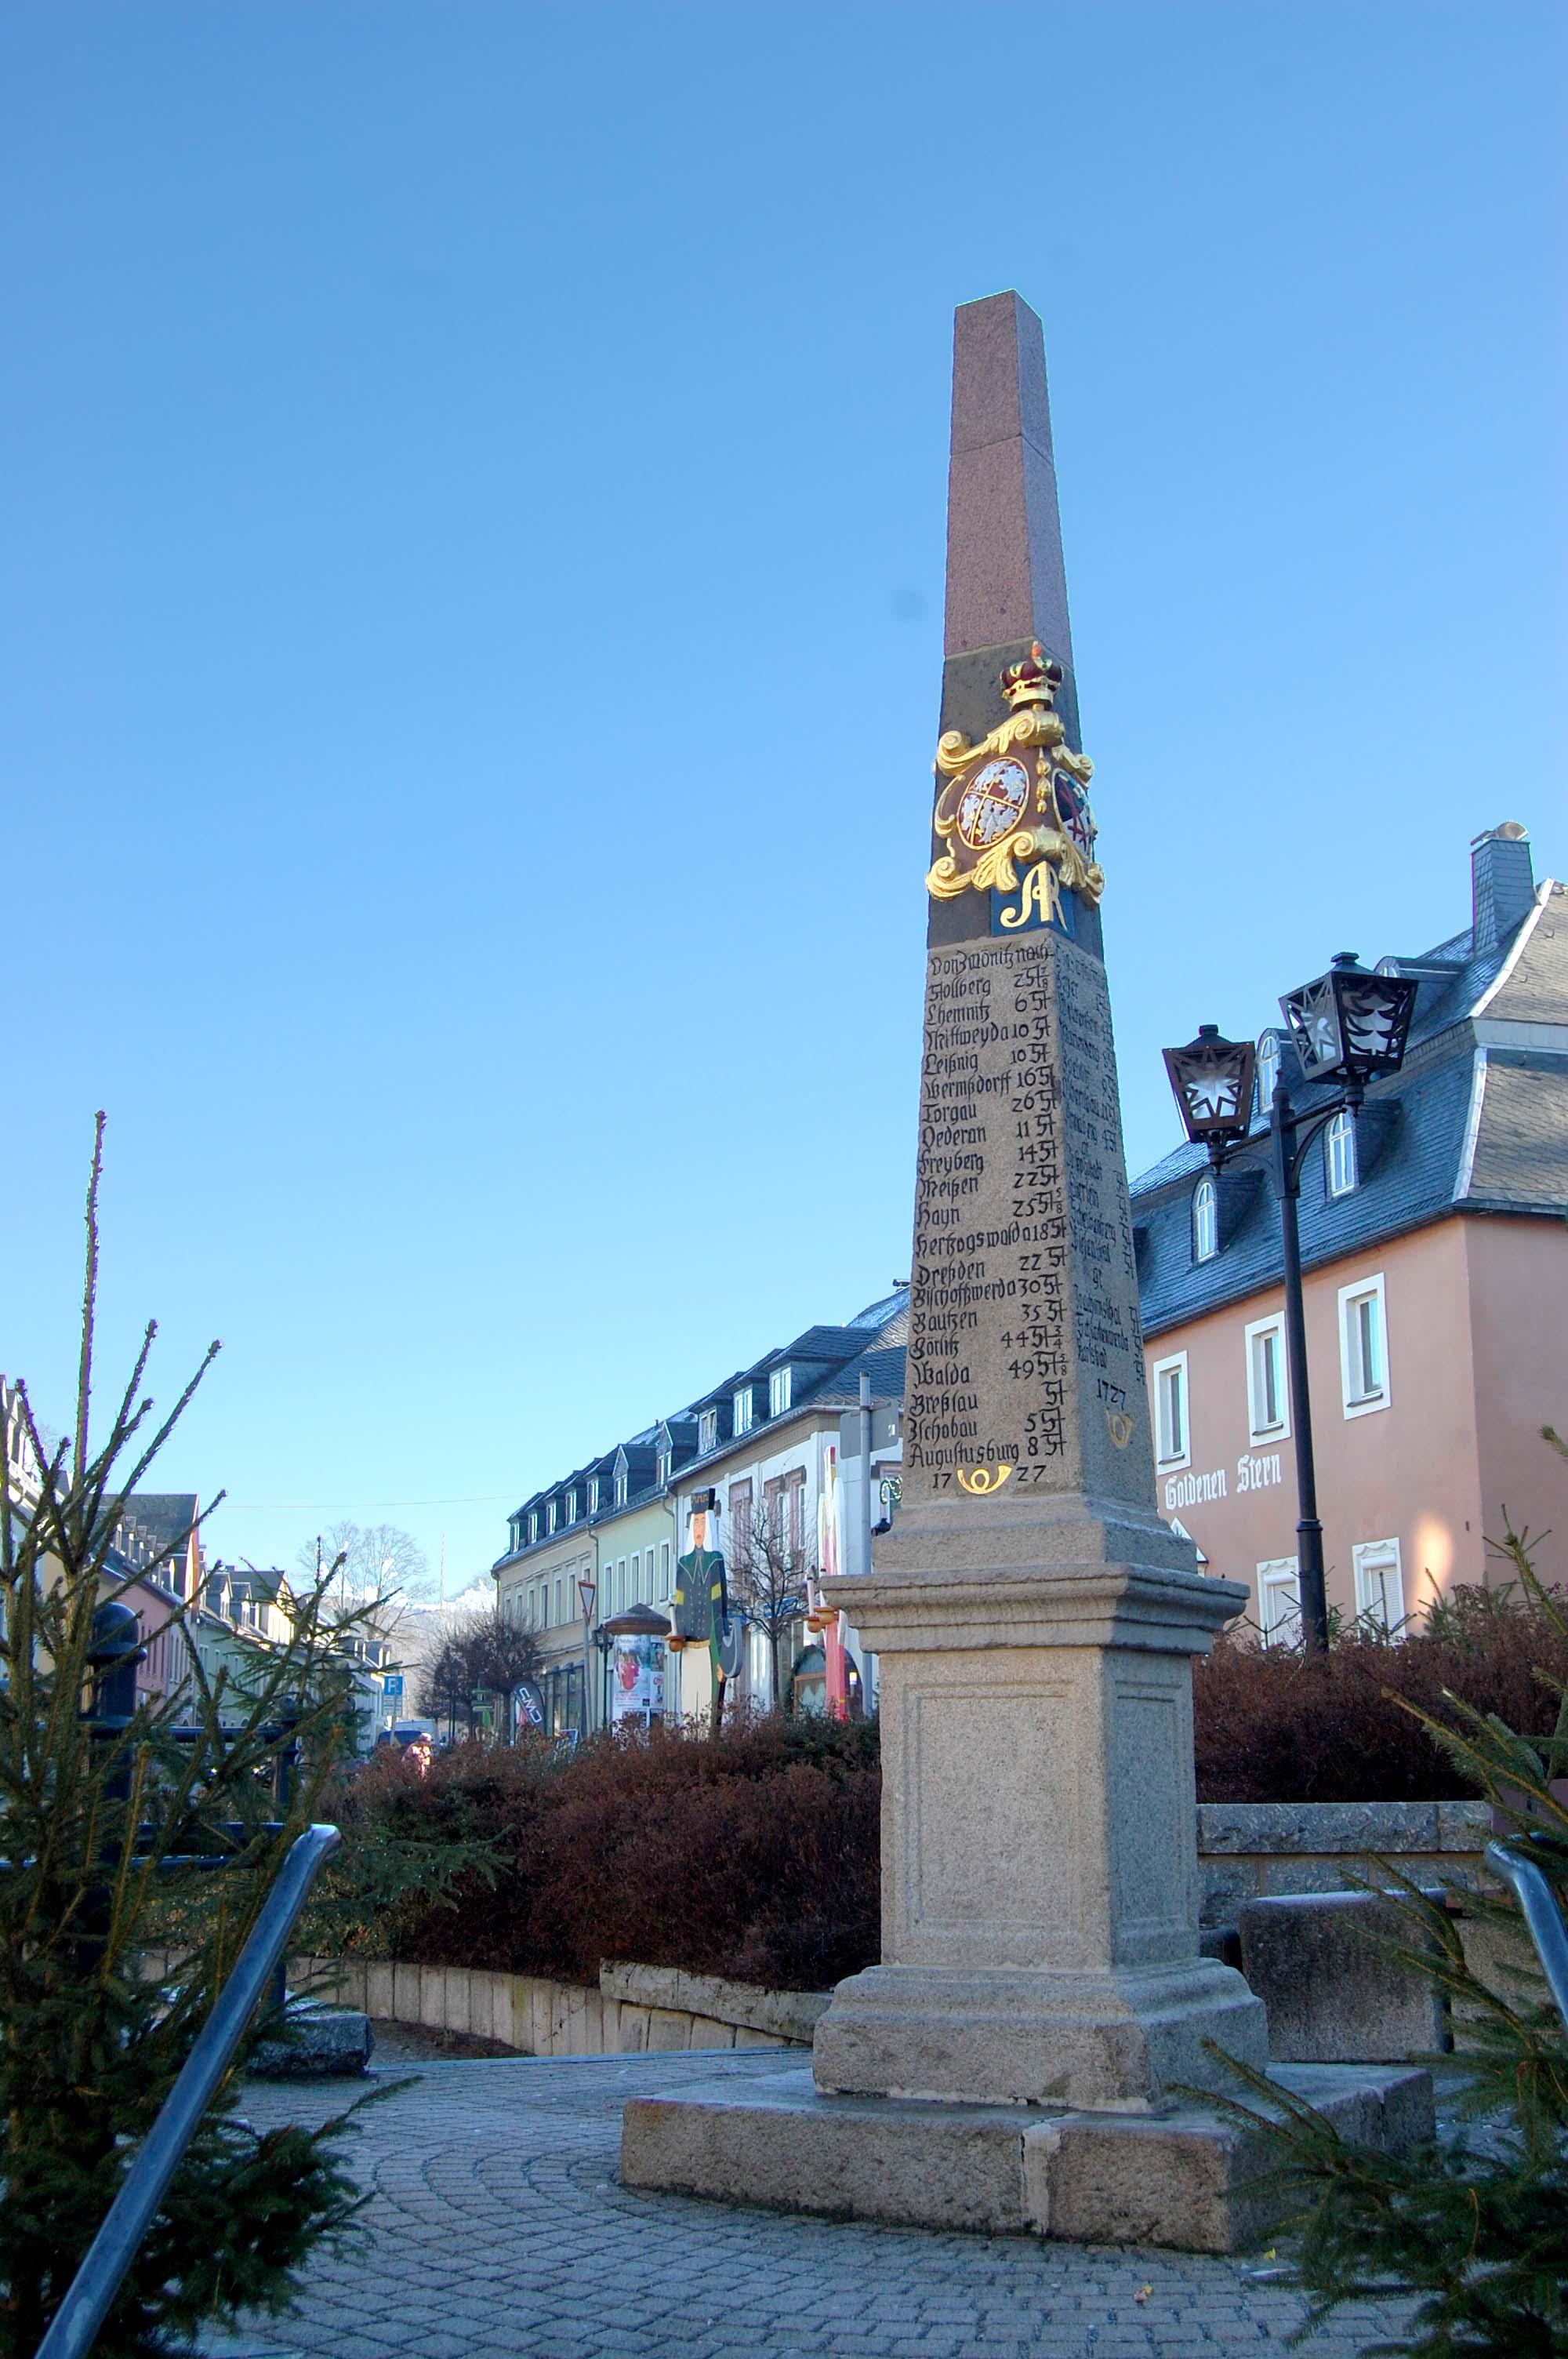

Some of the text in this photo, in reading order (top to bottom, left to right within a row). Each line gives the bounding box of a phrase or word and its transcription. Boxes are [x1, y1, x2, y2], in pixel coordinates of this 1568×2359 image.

[1014, 974, 1025, 988] 2
[1015, 994, 1027, 1012] 6
[1012, 1023, 1029, 1038] 10
[1010, 1049, 1026, 1064] 10
[1017, 1067, 1036, 1088] 16
[922, 1103, 977, 1125] Torgau
[1012, 1091, 1034, 1112] 26
[922, 1125, 986, 1148] Oederan
[1016, 1121, 1029, 1138] 11
[919, 1149, 984, 1176] Freyberg
[1018, 1143, 1037, 1164] 14
[1014, 1172, 1038, 1188] 22
[916, 1201, 960, 1230] Hayn
[1012, 1198, 1037, 1217] 25
[1033, 1223, 1048, 1241] 18
[1019, 1254, 1041, 1270] 22
[1018, 1278, 1040, 1297] 30
[913, 1307, 978, 1334] Bautzen
[1022, 1303, 1042, 1321] 35
[1001, 1331, 1029, 1348] 44
[1008, 1360, 1033, 1380] 49
[1097, 1379, 1126, 1410] 1727
[1024, 1413, 1037, 1432] 5
[1028, 1436, 1038, 1456] 8
[932, 1465, 1046, 1488] 17 27
[1165, 1469, 1227, 1510] Goldenen
[1236, 1453, 1282, 1494] Stern
